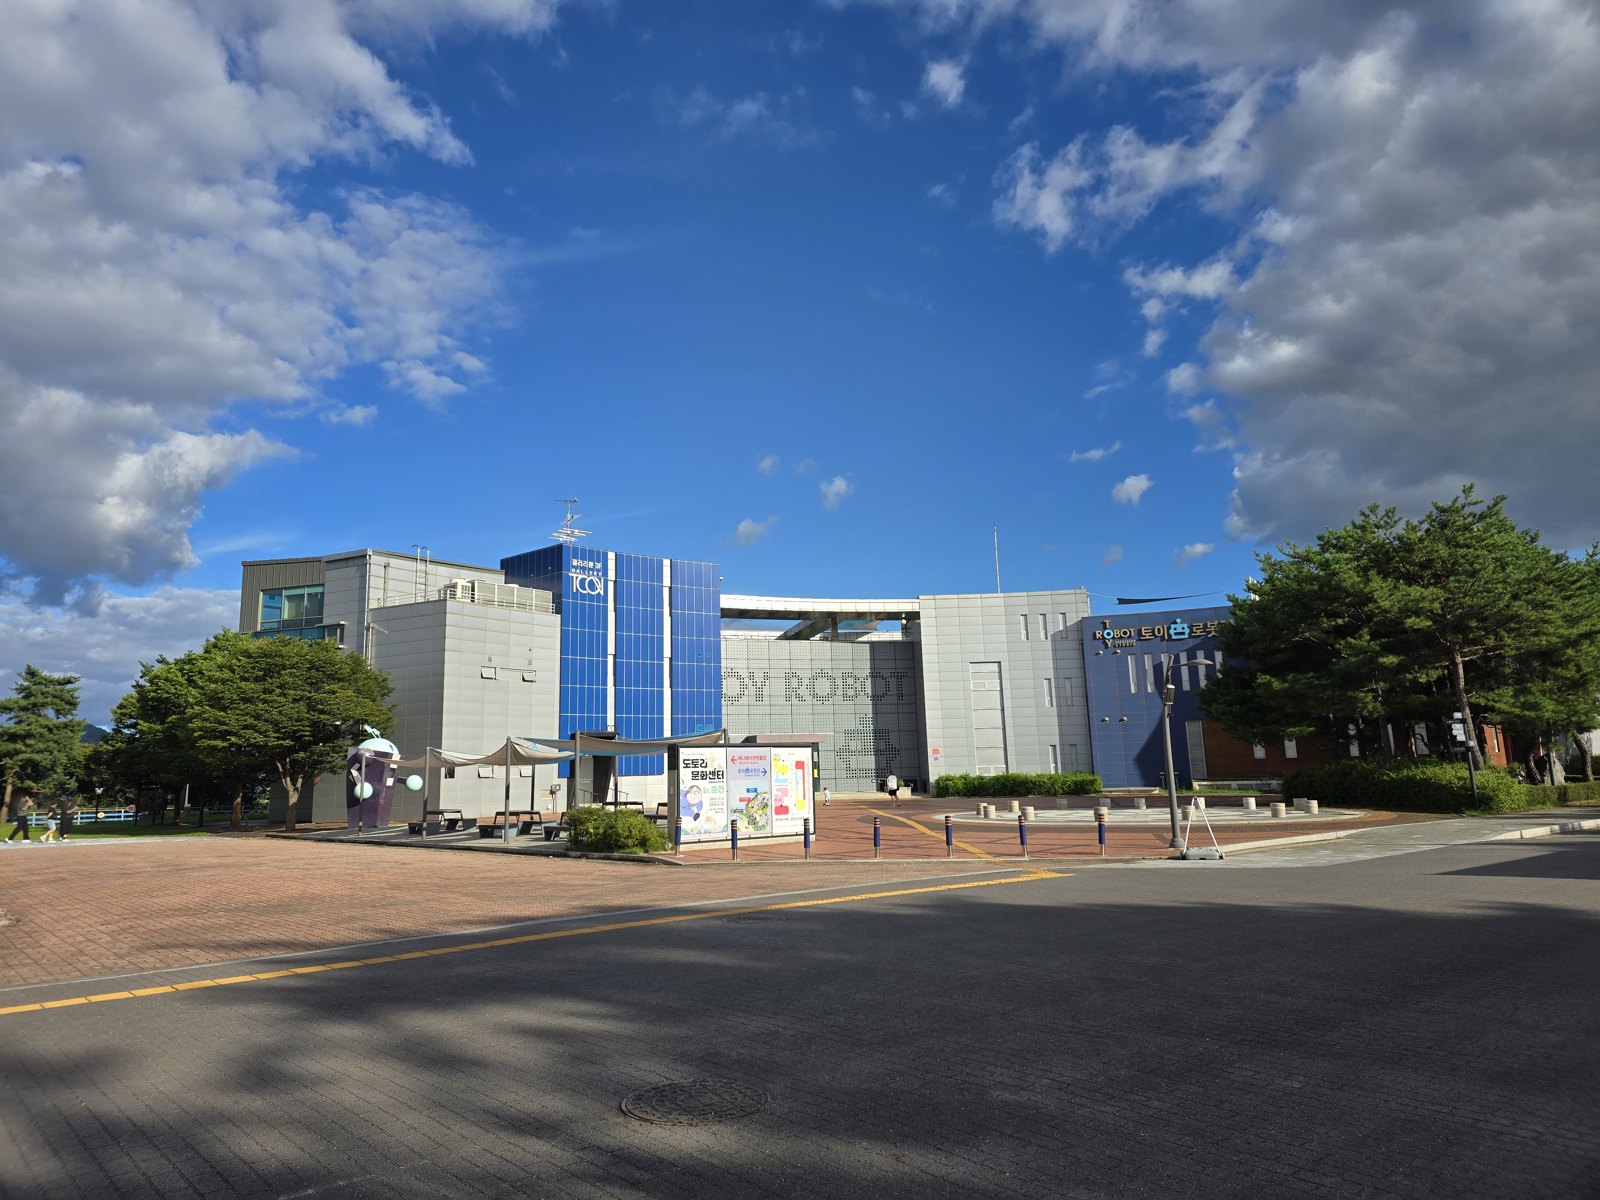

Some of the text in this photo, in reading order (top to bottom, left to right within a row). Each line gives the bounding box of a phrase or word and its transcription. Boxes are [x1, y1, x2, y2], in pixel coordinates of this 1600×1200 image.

[1095, 629, 1135, 640] ROBOT
[1140, 624, 1168, 640] 토이
[784, 668, 908, 705] ROBOT
[682, 758, 708, 769] 도토리
[691, 767, 725, 781] 문화센터
